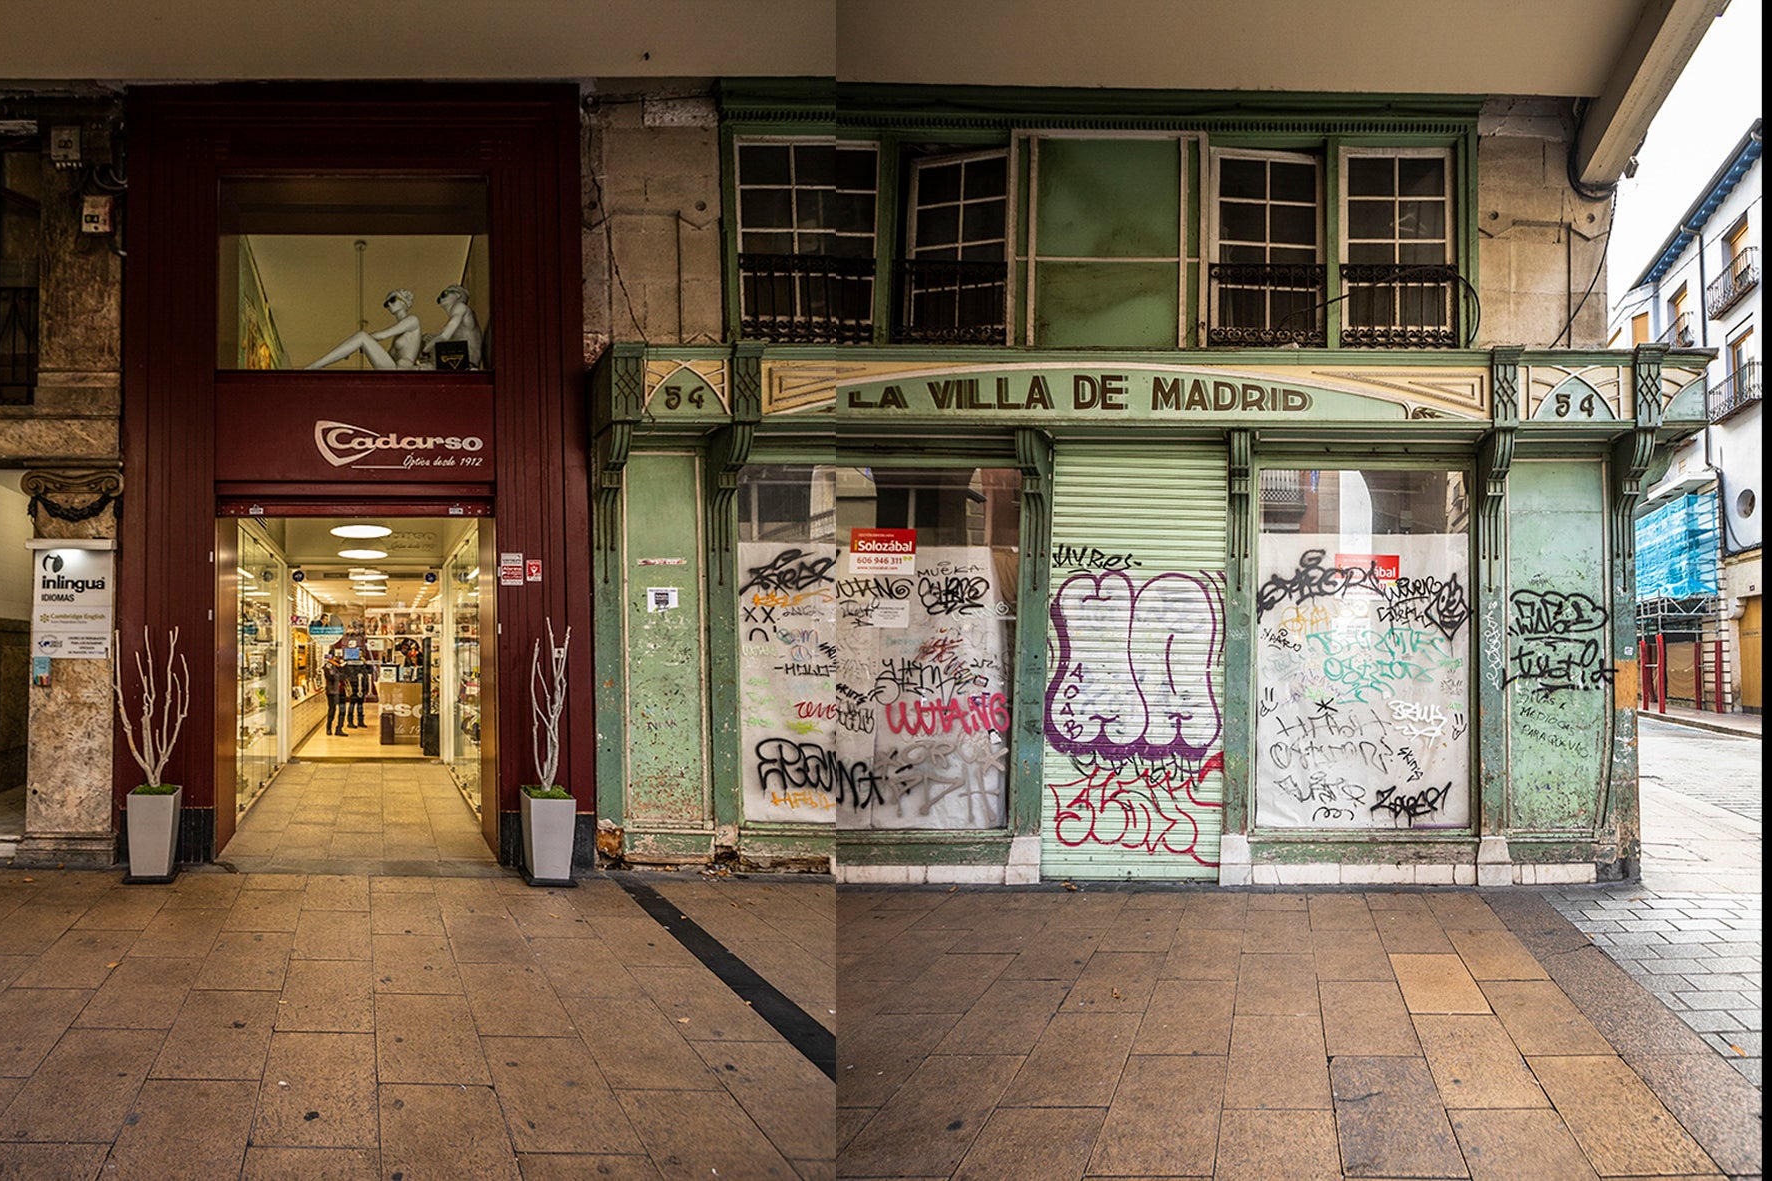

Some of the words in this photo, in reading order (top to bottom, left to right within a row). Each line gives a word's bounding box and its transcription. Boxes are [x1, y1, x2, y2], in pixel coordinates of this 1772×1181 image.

[665, 386, 704, 410] 54
[848, 384, 909, 409] LA
[927, 375, 1054, 410] VILLA
[1073, 374, 1129, 411] DE
[1151, 376, 1313, 412] MADRID
[1556, 394, 1595, 418] 54
[326, 427, 484, 451] Cadarso
[433, 456, 456, 467] desde
[459, 457, 484, 467] 1912
[857, 556, 872, 564] 606
[874, 556, 889, 564] 946
[42, 574, 105, 593] inlingua
[41, 594, 75, 602] IDIOMAS
